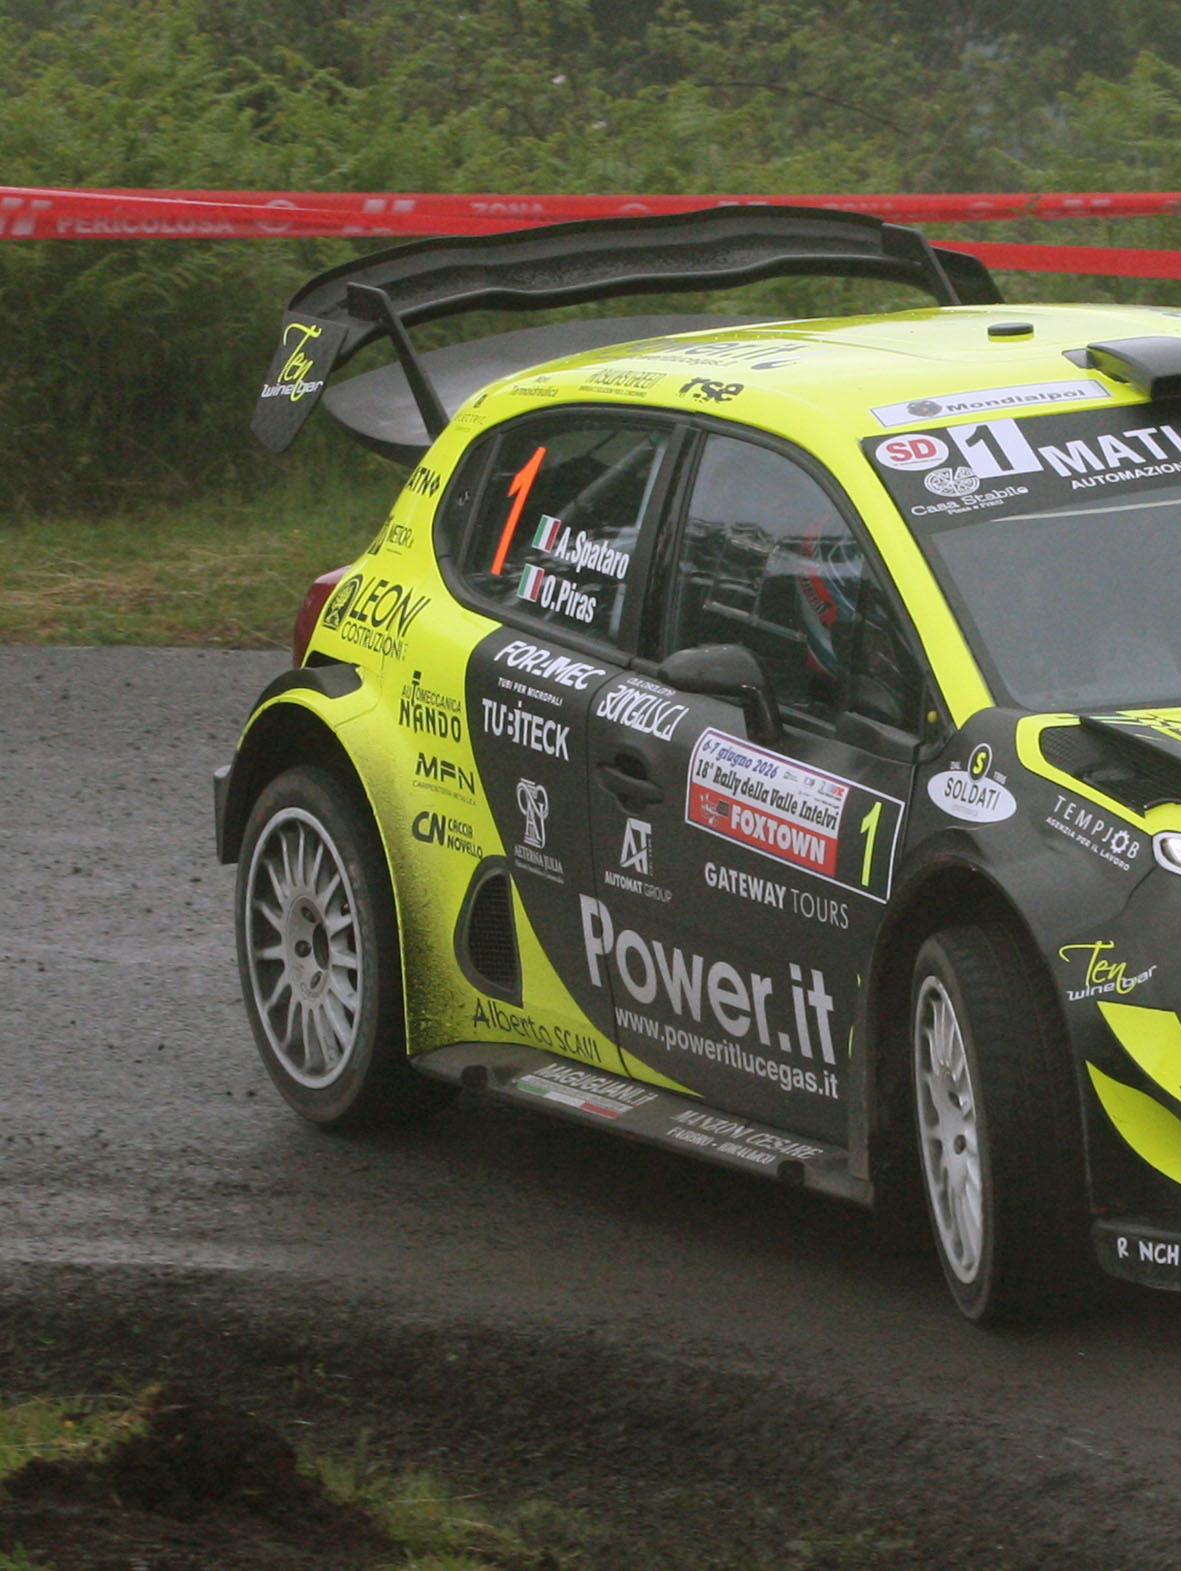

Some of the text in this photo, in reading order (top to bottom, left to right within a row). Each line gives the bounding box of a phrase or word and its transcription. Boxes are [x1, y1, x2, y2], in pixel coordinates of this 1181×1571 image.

[946, 388, 1087, 413] Mondialpol
[885, 438, 938, 463] SD
[964, 424, 1016, 473] 1
[490, 446, 548, 576] 1
[911, 486, 1029, 517] Casa Stabile
[555, 526, 631, 580] A.Spataro
[541, 575, 597, 624] O.Piras
[399, 699, 461, 743] NANDO
[713, 766, 741, 797] Rally
[741, 777, 770, 802] della
[769, 788, 798, 816] Valle
[798, 801, 840, 831] Intelvi
[944, 777, 1001, 811] SOLDATI
[731, 804, 826, 865] FOXTOWN
[860, 801, 883, 887] 1
[1076, 834, 1092, 848] PER
[1100, 849, 1130, 872] LAVORO
[604, 870, 643, 894] AUTOMAT
[704, 861, 849, 929] GATEWAY TOURS
[579, 893, 836, 1065] Power.it
[1059, 940, 1137, 995] Ten
[473, 998, 553, 1047] Alberto
[615, 1006, 839, 1100] www.poweritlucegas.it
